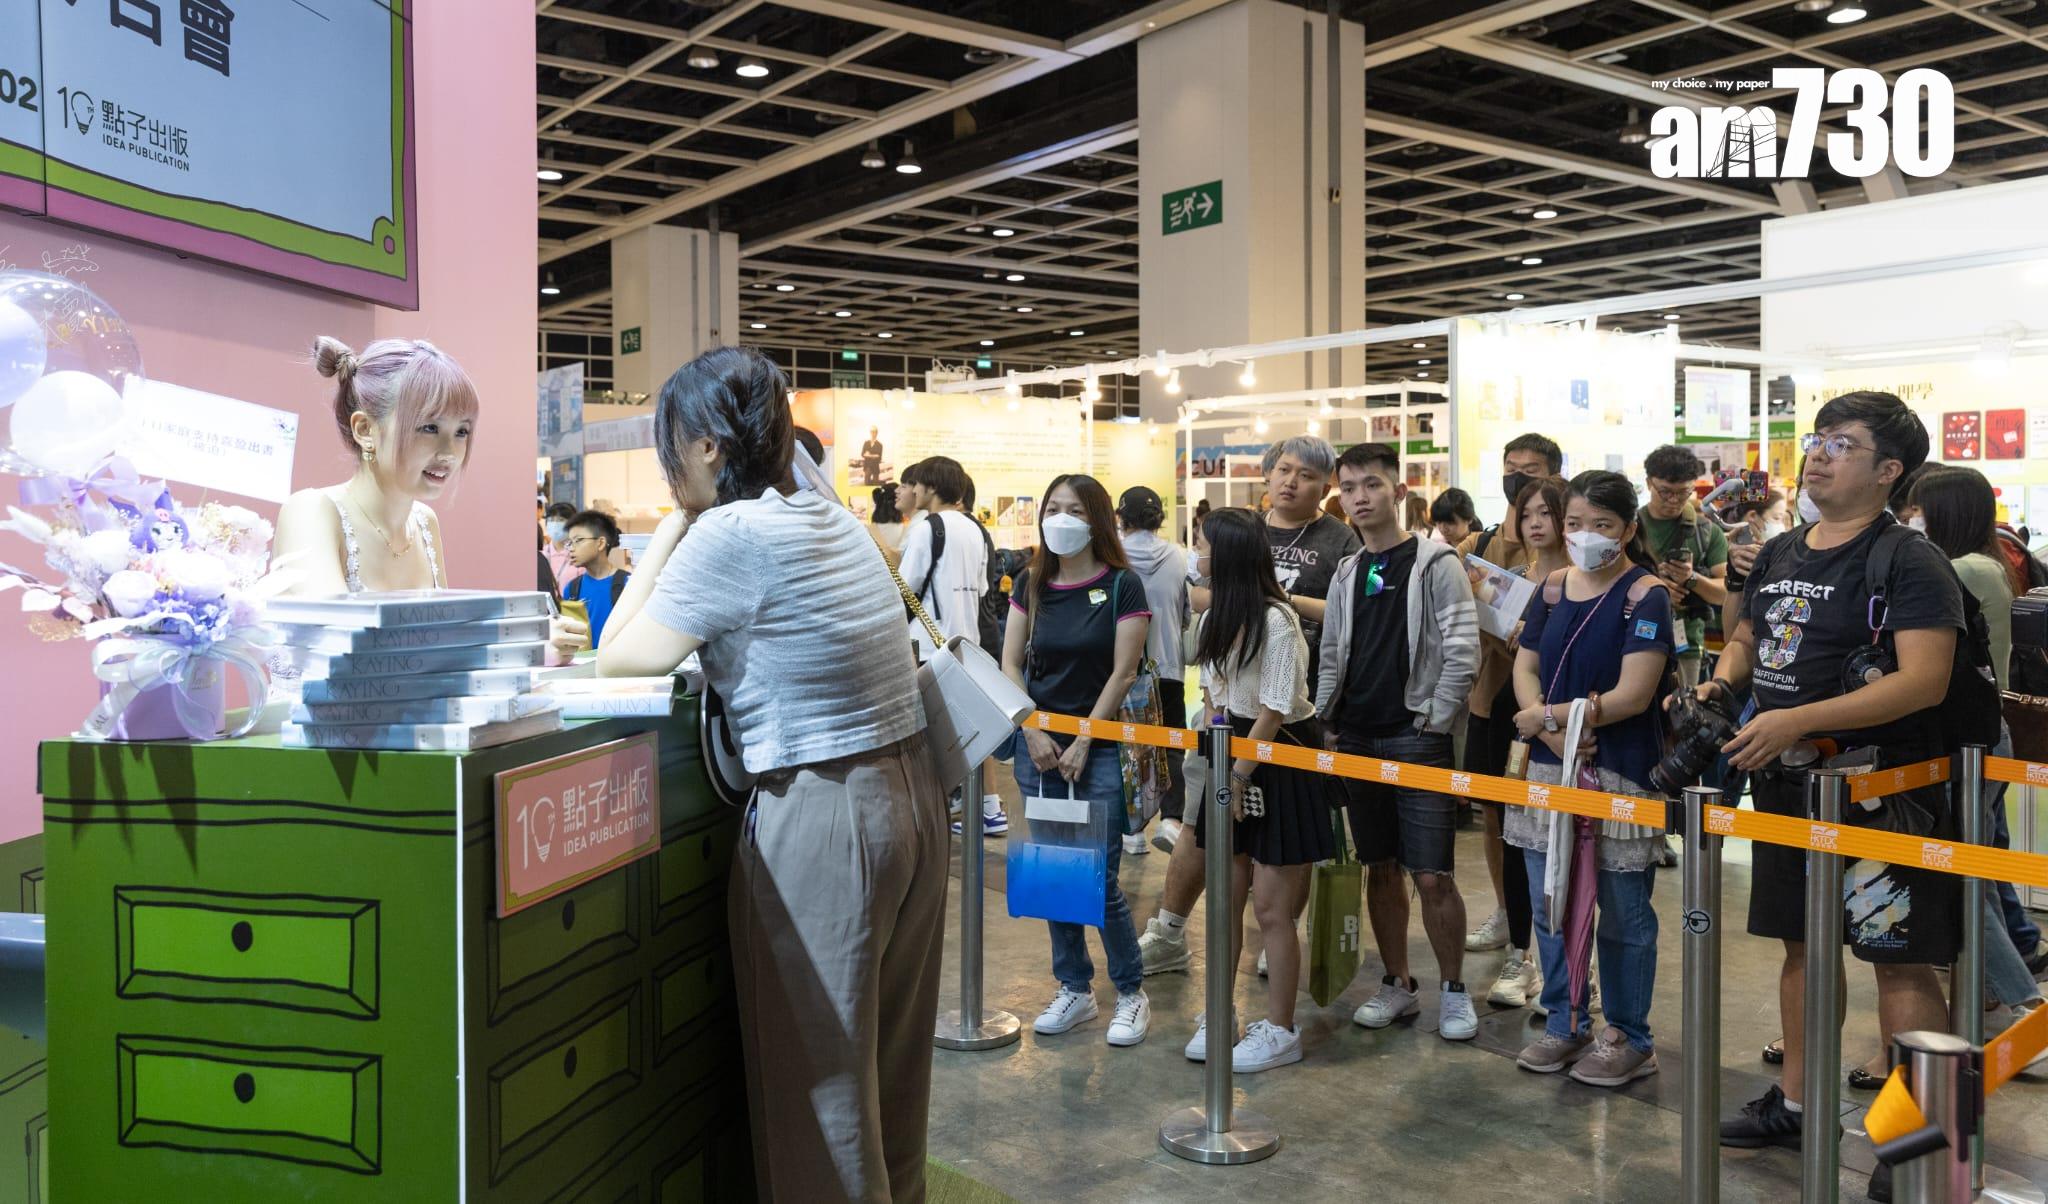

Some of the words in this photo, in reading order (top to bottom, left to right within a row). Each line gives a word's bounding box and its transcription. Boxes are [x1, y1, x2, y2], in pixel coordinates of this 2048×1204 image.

[101, 100, 189, 158] 點子出版
[102, 134, 126, 151] IDEA
[128, 142, 190, 172] PUBLICATION
[399, 605, 455, 623] KAYING
[373, 627, 440, 649] KAYING
[351, 654, 424, 676] KAYING
[562, 765, 649, 833] 點子出版
[563, 838, 587, 857] IDEA
[589, 812, 649, 847] PUBLICATION
